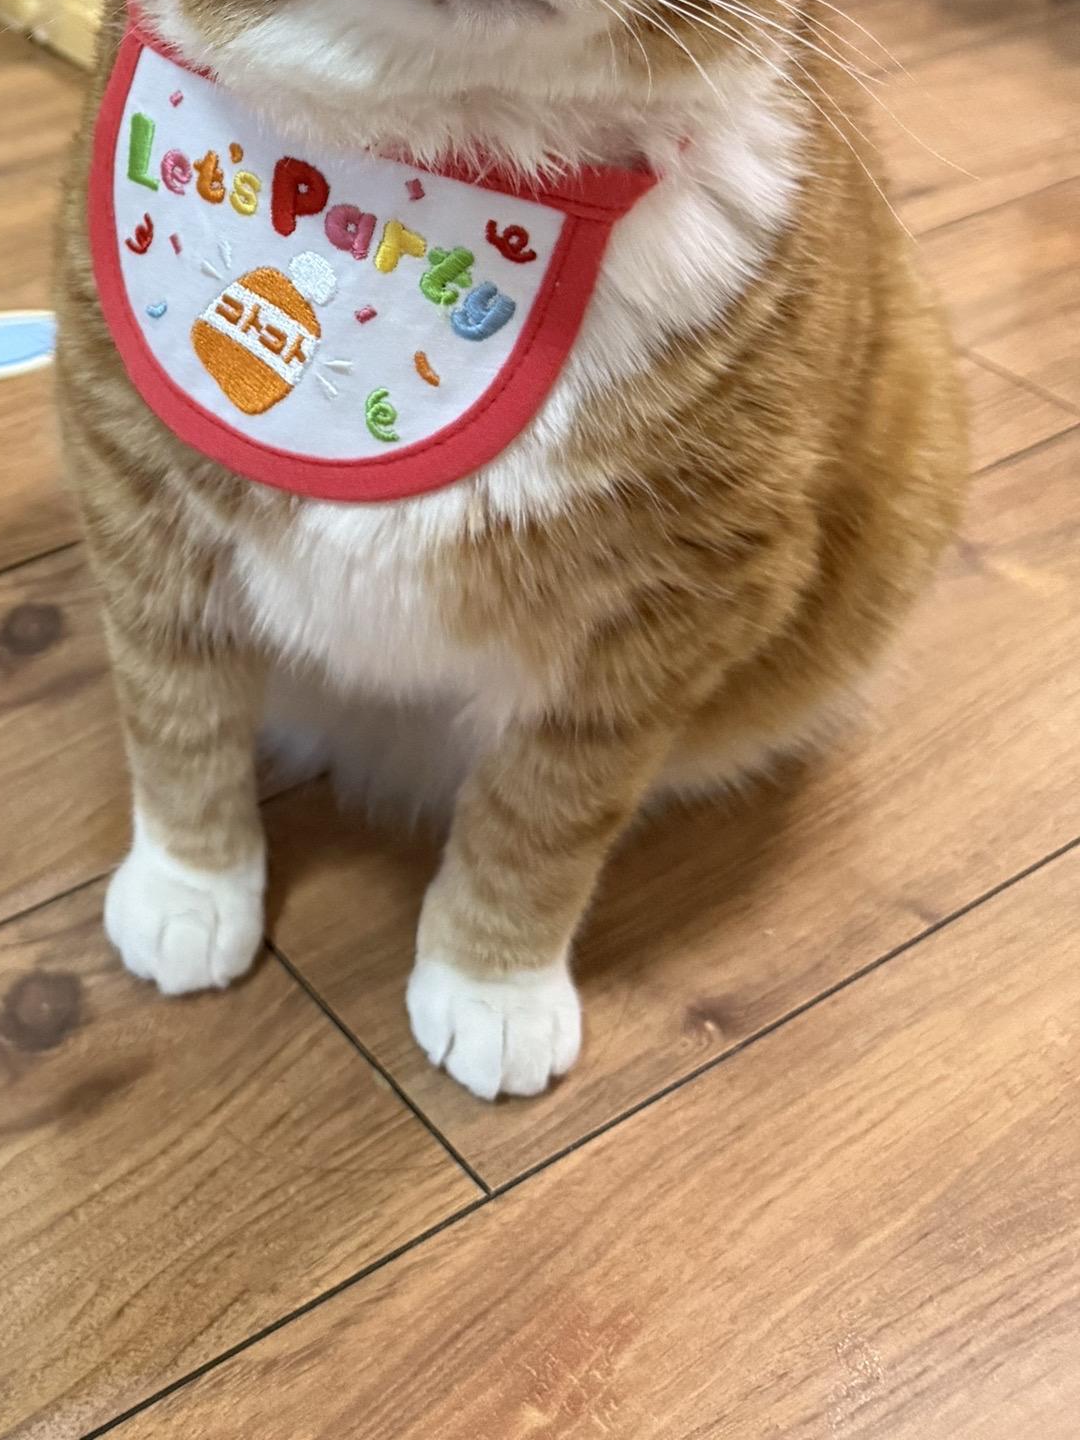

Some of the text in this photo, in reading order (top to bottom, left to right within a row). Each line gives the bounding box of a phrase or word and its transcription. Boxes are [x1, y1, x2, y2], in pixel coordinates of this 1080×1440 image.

[127, 112, 516, 342] Let's Party
[215, 293, 307, 364] コトコト
